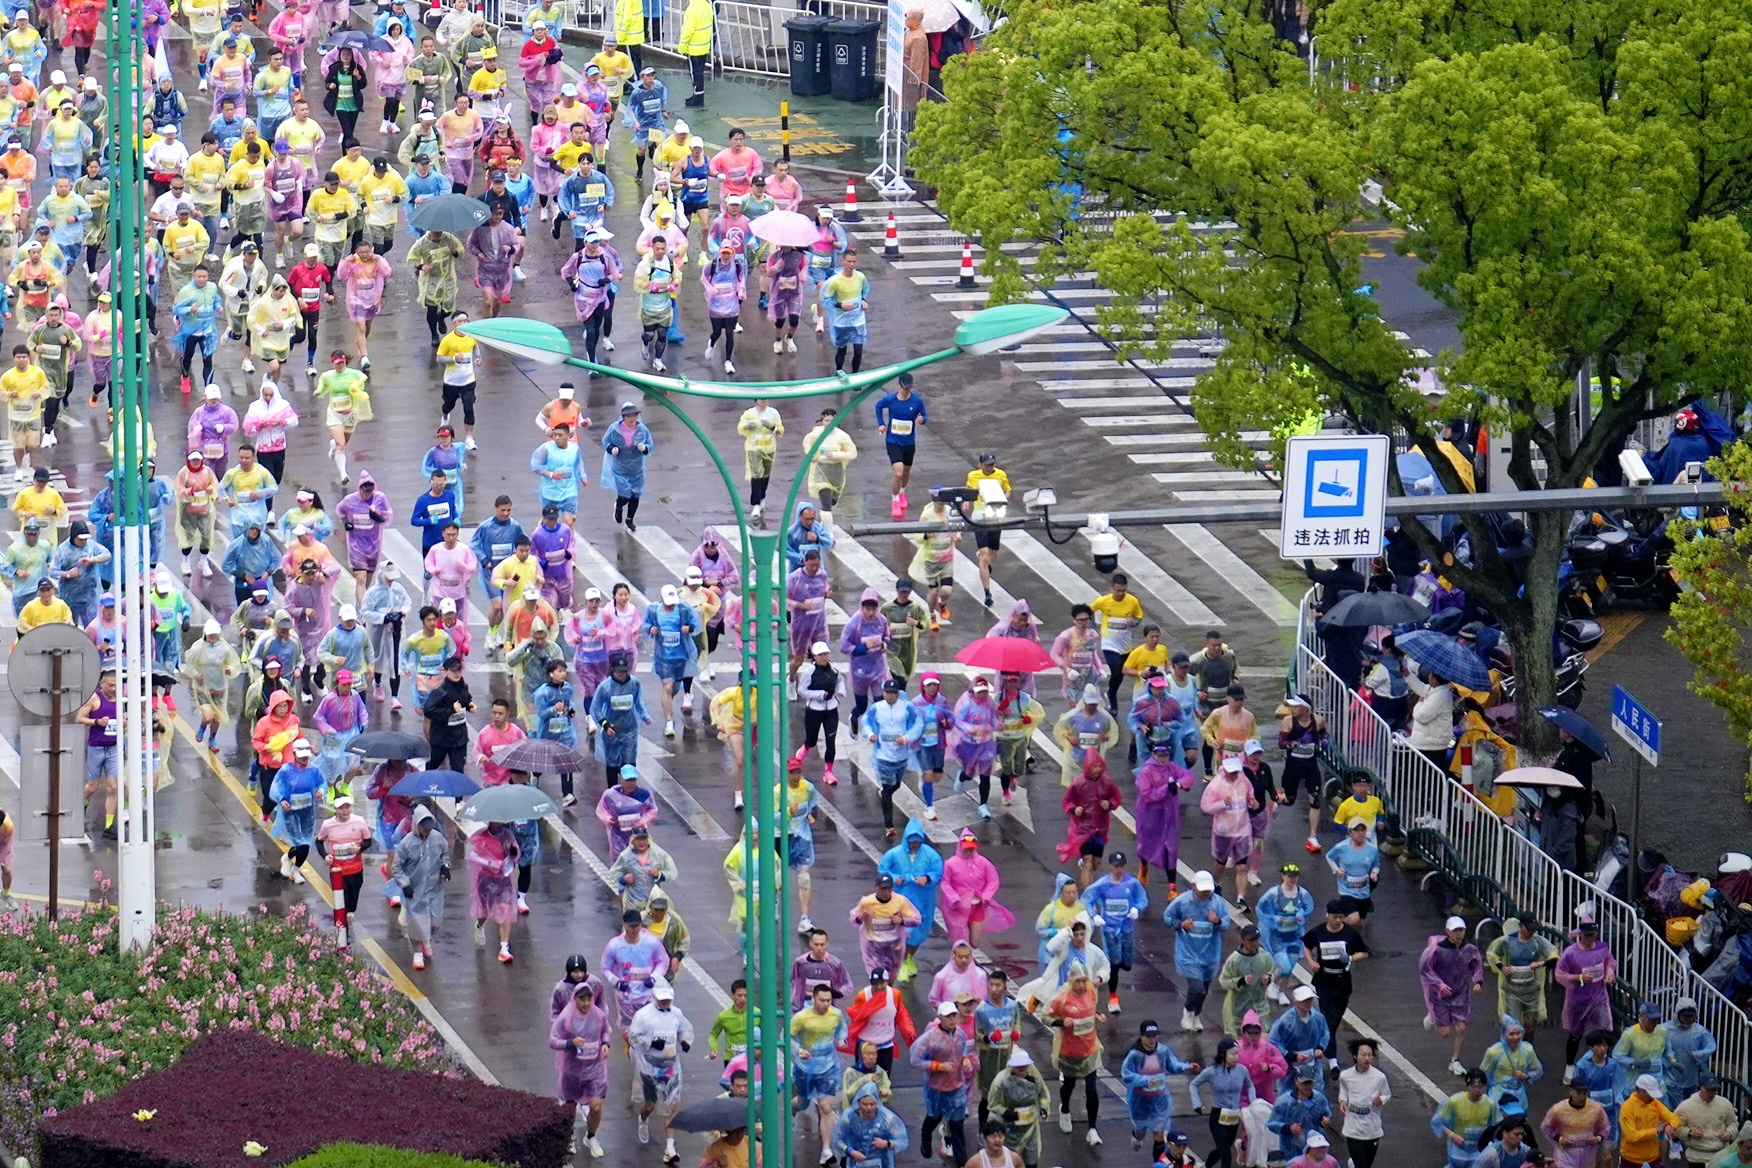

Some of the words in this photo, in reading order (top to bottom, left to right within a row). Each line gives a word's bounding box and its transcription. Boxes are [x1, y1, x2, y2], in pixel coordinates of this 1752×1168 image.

[1294, 527, 1370, 546] 违法抓拍
[1620, 698, 1650, 741] 人民街
